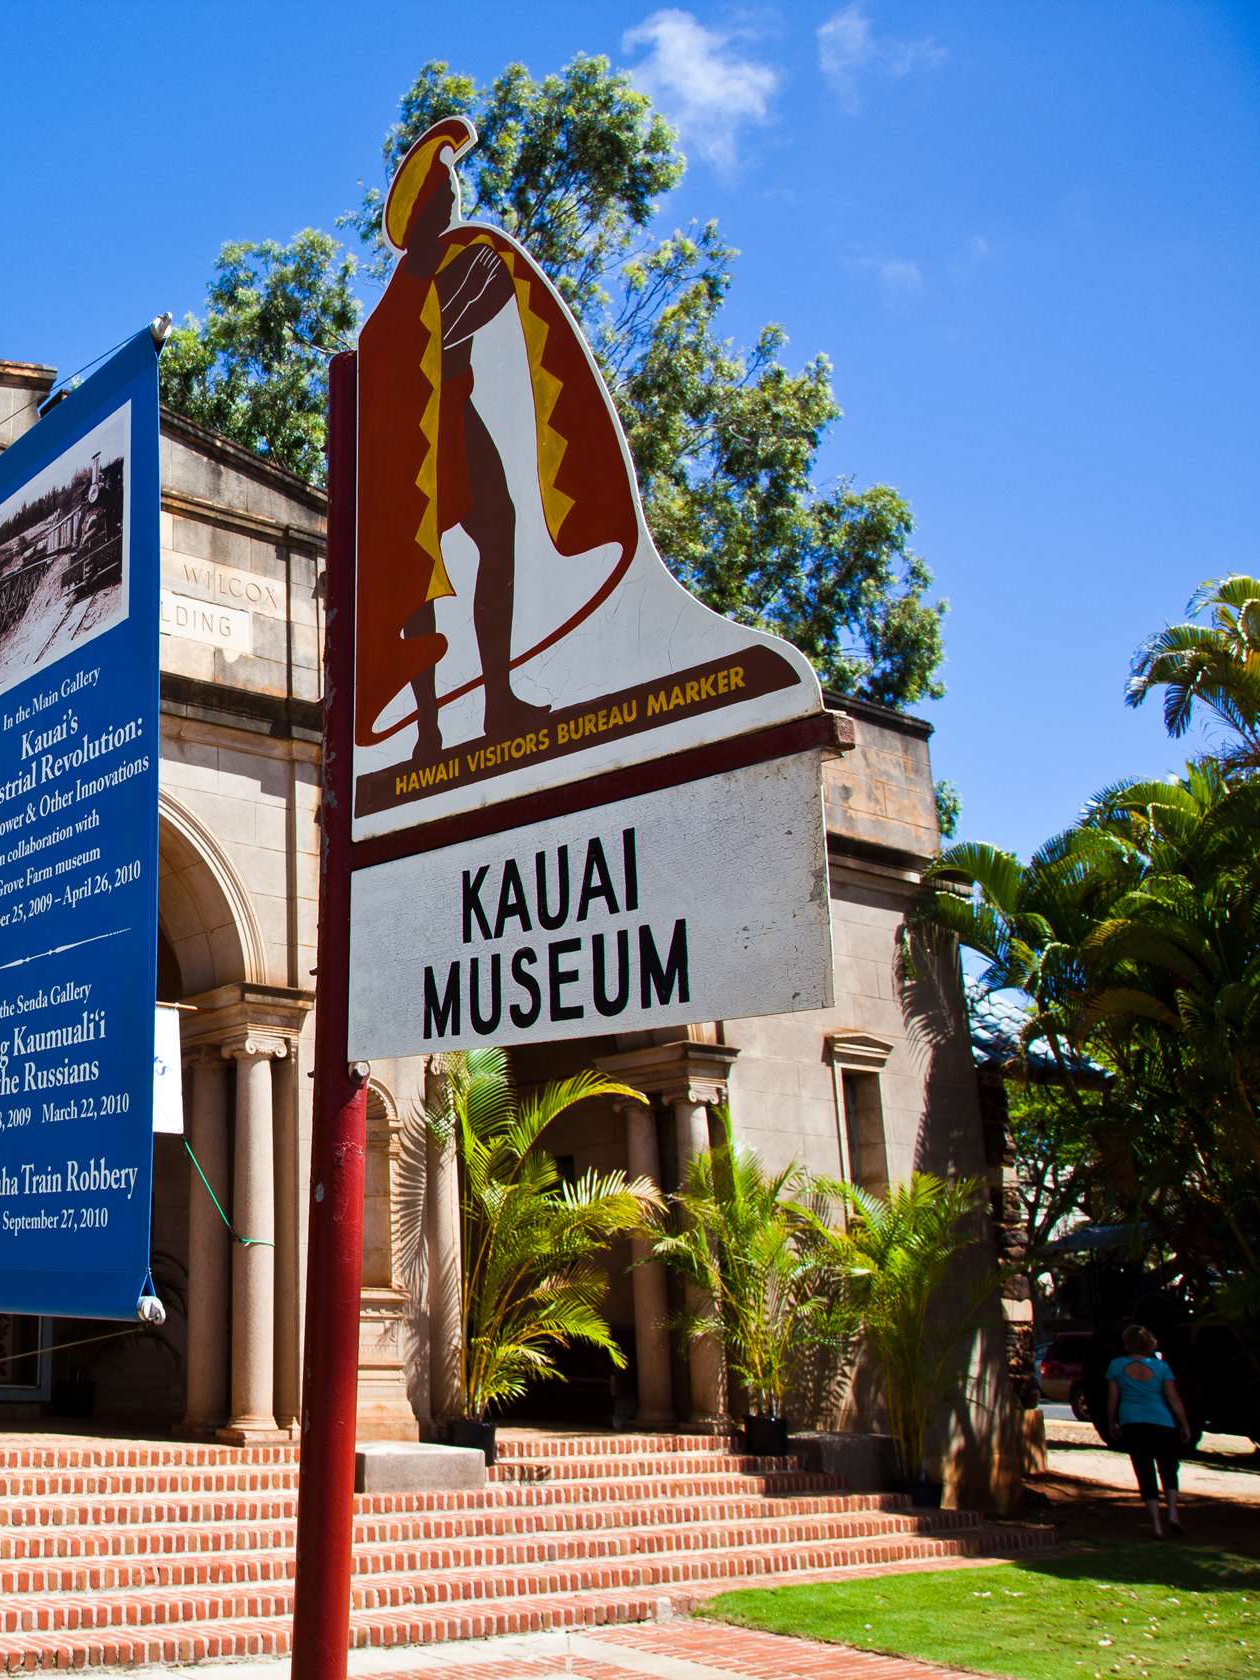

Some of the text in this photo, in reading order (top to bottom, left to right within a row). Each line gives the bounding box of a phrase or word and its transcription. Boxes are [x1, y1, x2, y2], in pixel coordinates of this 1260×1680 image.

[183, 564, 277, 609] WILCOX
[160, 601, 231, 637] LDING
[3, 667, 100, 731] In the Main Gallery
[21, 710, 78, 760] Kauai's
[41, 718, 142, 783] Revolution:
[396, 667, 746, 795] HAWAII VISITORS BUREAU MARKER
[26, 806, 37, 822] &
[40, 790, 73, 817] Other
[76, 756, 149, 801] Innovations
[8, 824, 72, 864] collaboration
[76, 809, 100, 834] with
[12, 906, 26, 922] 25,
[29, 893, 52, 916] 2009
[62, 877, 92, 908] April
[94, 874, 112, 894] 26,
[114, 860, 140, 887] 2010
[26, 864, 52, 886] Farm
[55, 847, 100, 877] museum
[462, 827, 639, 944] KAUAI
[0, 1000, 14, 1019] the
[17, 989, 48, 1013] Senda
[50, 981, 92, 1005] Gallery
[424, 919, 690, 1040] MUSEUM
[24, 1058, 99, 1092] Russians
[7, 1107, 31, 1128] 2009
[42, 1099, 77, 1123] March
[81, 1098, 98, 1120] 22,
[100, 1093, 129, 1115] 2010
[21, 1163, 62, 1195] Train
[67, 1157, 138, 1199] Robbery
[3, 1209, 59, 1236] September
[61, 1209, 77, 1232] 27,
[80, 1207, 108, 1228] 2010
